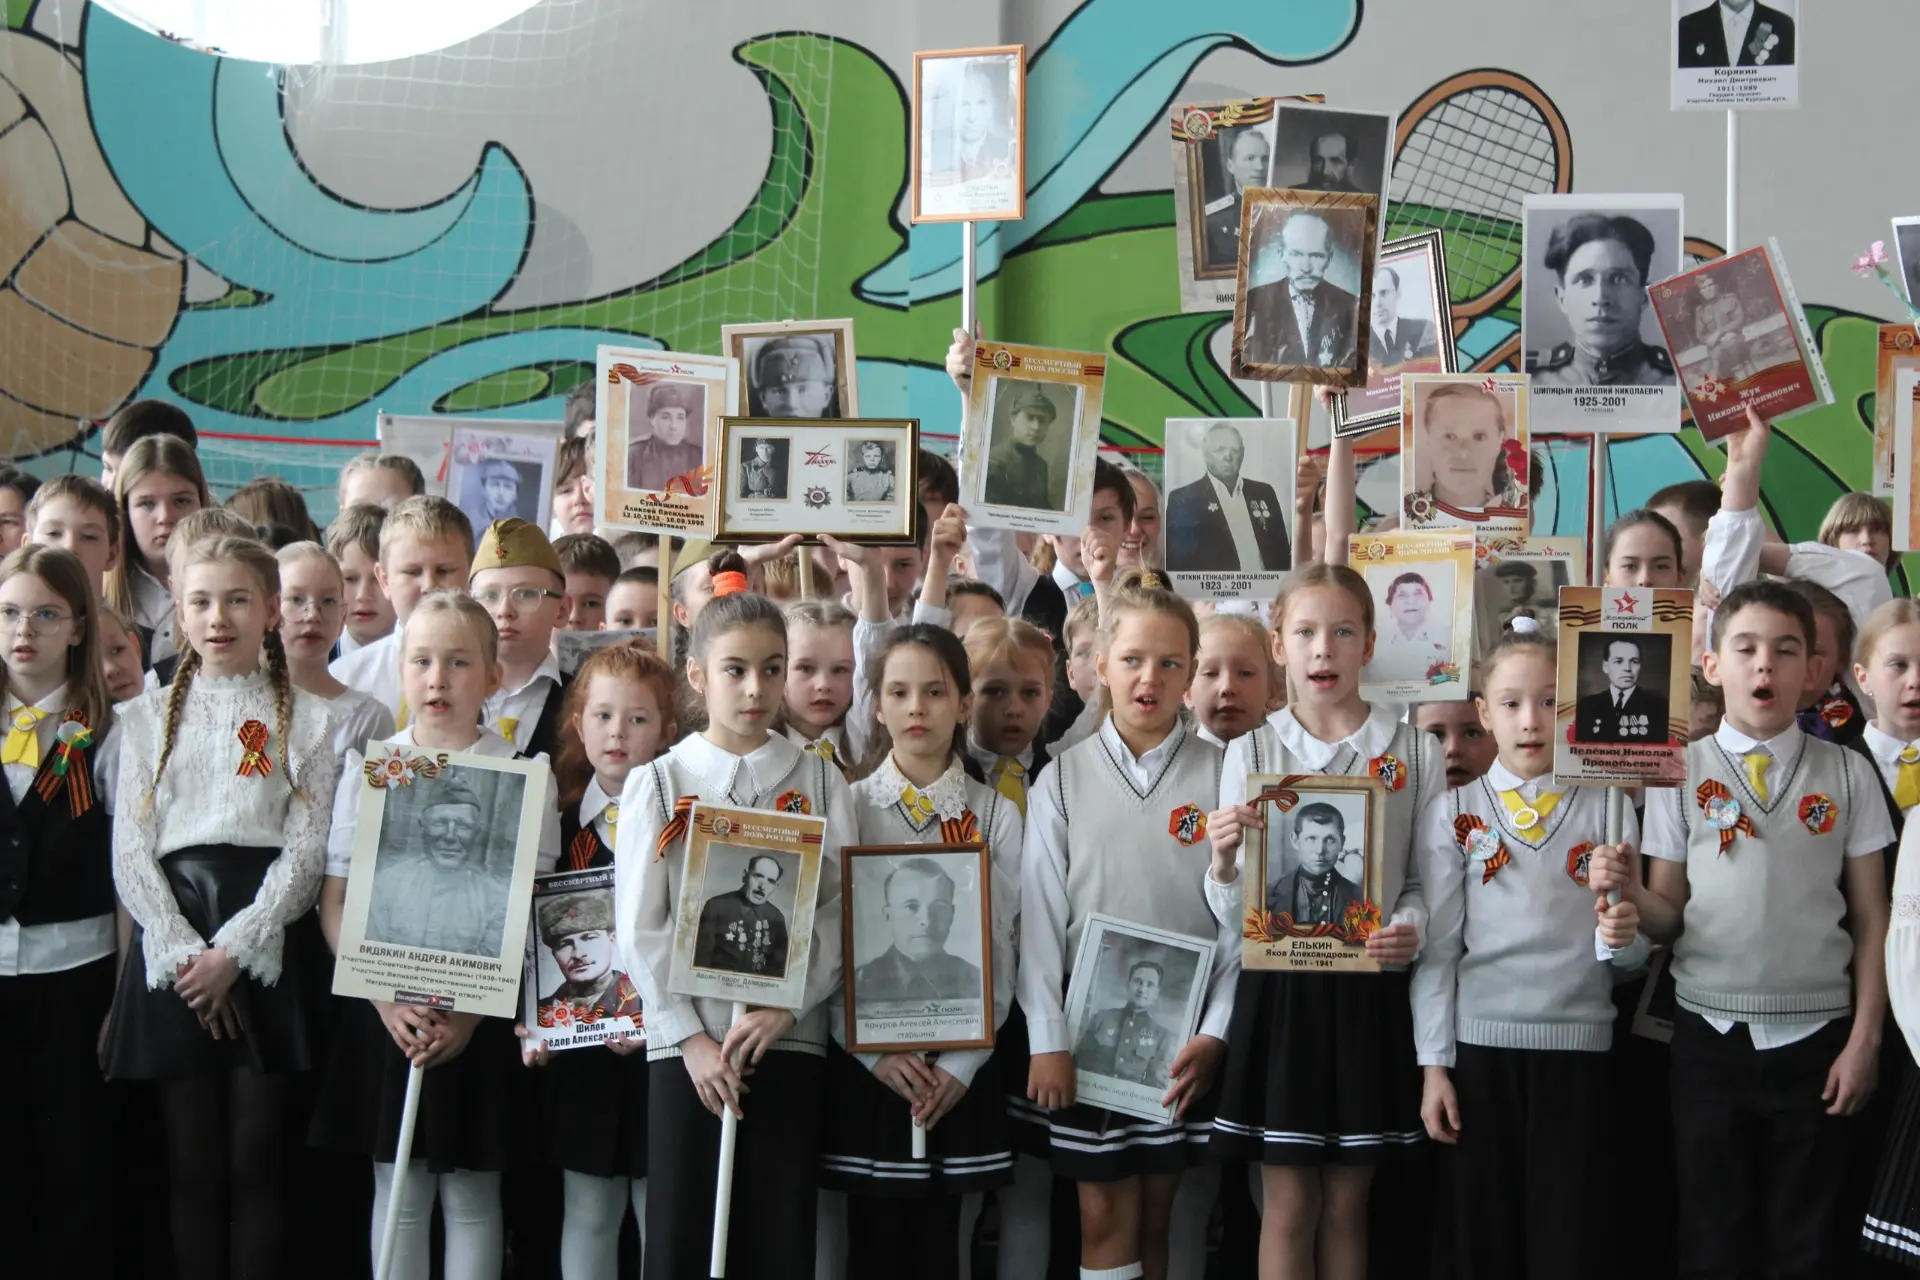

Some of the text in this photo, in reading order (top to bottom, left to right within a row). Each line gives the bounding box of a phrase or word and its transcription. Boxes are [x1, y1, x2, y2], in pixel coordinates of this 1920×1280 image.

[1714, 68, 1757, 77] Корякин
[1729, 76, 1777, 84] Дмитриевич
[1024, 357, 1082, 369] БЕССМЕРТНЫЙ
[1534, 385, 1664, 395] ШИПИЦЫН АНАТОЛИЙ НИКОЛАЕВИЧ
[1739, 385, 1761, 399] Жук
[1573, 396, 1626, 407] 1925-2001
[1707, 400, 1749, 422] Николай
[624, 505, 657, 514] Алексей
[1202, 573, 1235, 581] ГЕННАДИЙ
[1200, 581, 1221, 590] 1923
[1231, 581, 1252, 590] 2001
[1612, 622, 1639, 630] ПОЛК
[1622, 748, 1674, 757] Николай
[1582, 758, 1660, 768] Прокопьевич
[743, 823, 801, 837] БЕССМЕРТНЫЙ
[744, 831, 797, 843] ПОЛК РОССИИ
[548, 873, 608, 889] БЕССМЕРТНЫЙ
[1292, 941, 1332, 950] ЕЛЬКИН
[359, 944, 502, 972] ВИДЯКИН АНДРЕЙ АКИМОВИЧ
[1265, 949, 1359, 959] Яков Александрович
[341, 955, 376, 965] Участник
[377, 959, 447, 975] Советско-финской
[448, 970, 474, 979] войны
[1290, 959, 1307, 967] 1901
[351, 966, 504, 993] Участник Великой Отечественной войны
[742, 978, 779, 989] Давидович
[407, 984, 442, 995] медалью
[576, 1022, 606, 1034] Шилов
[865, 1017, 979, 1030] Кочуров Алексей Алексеевич
[897, 1031, 935, 1040] старшина
[544, 1037, 571, 1048] ёдор
